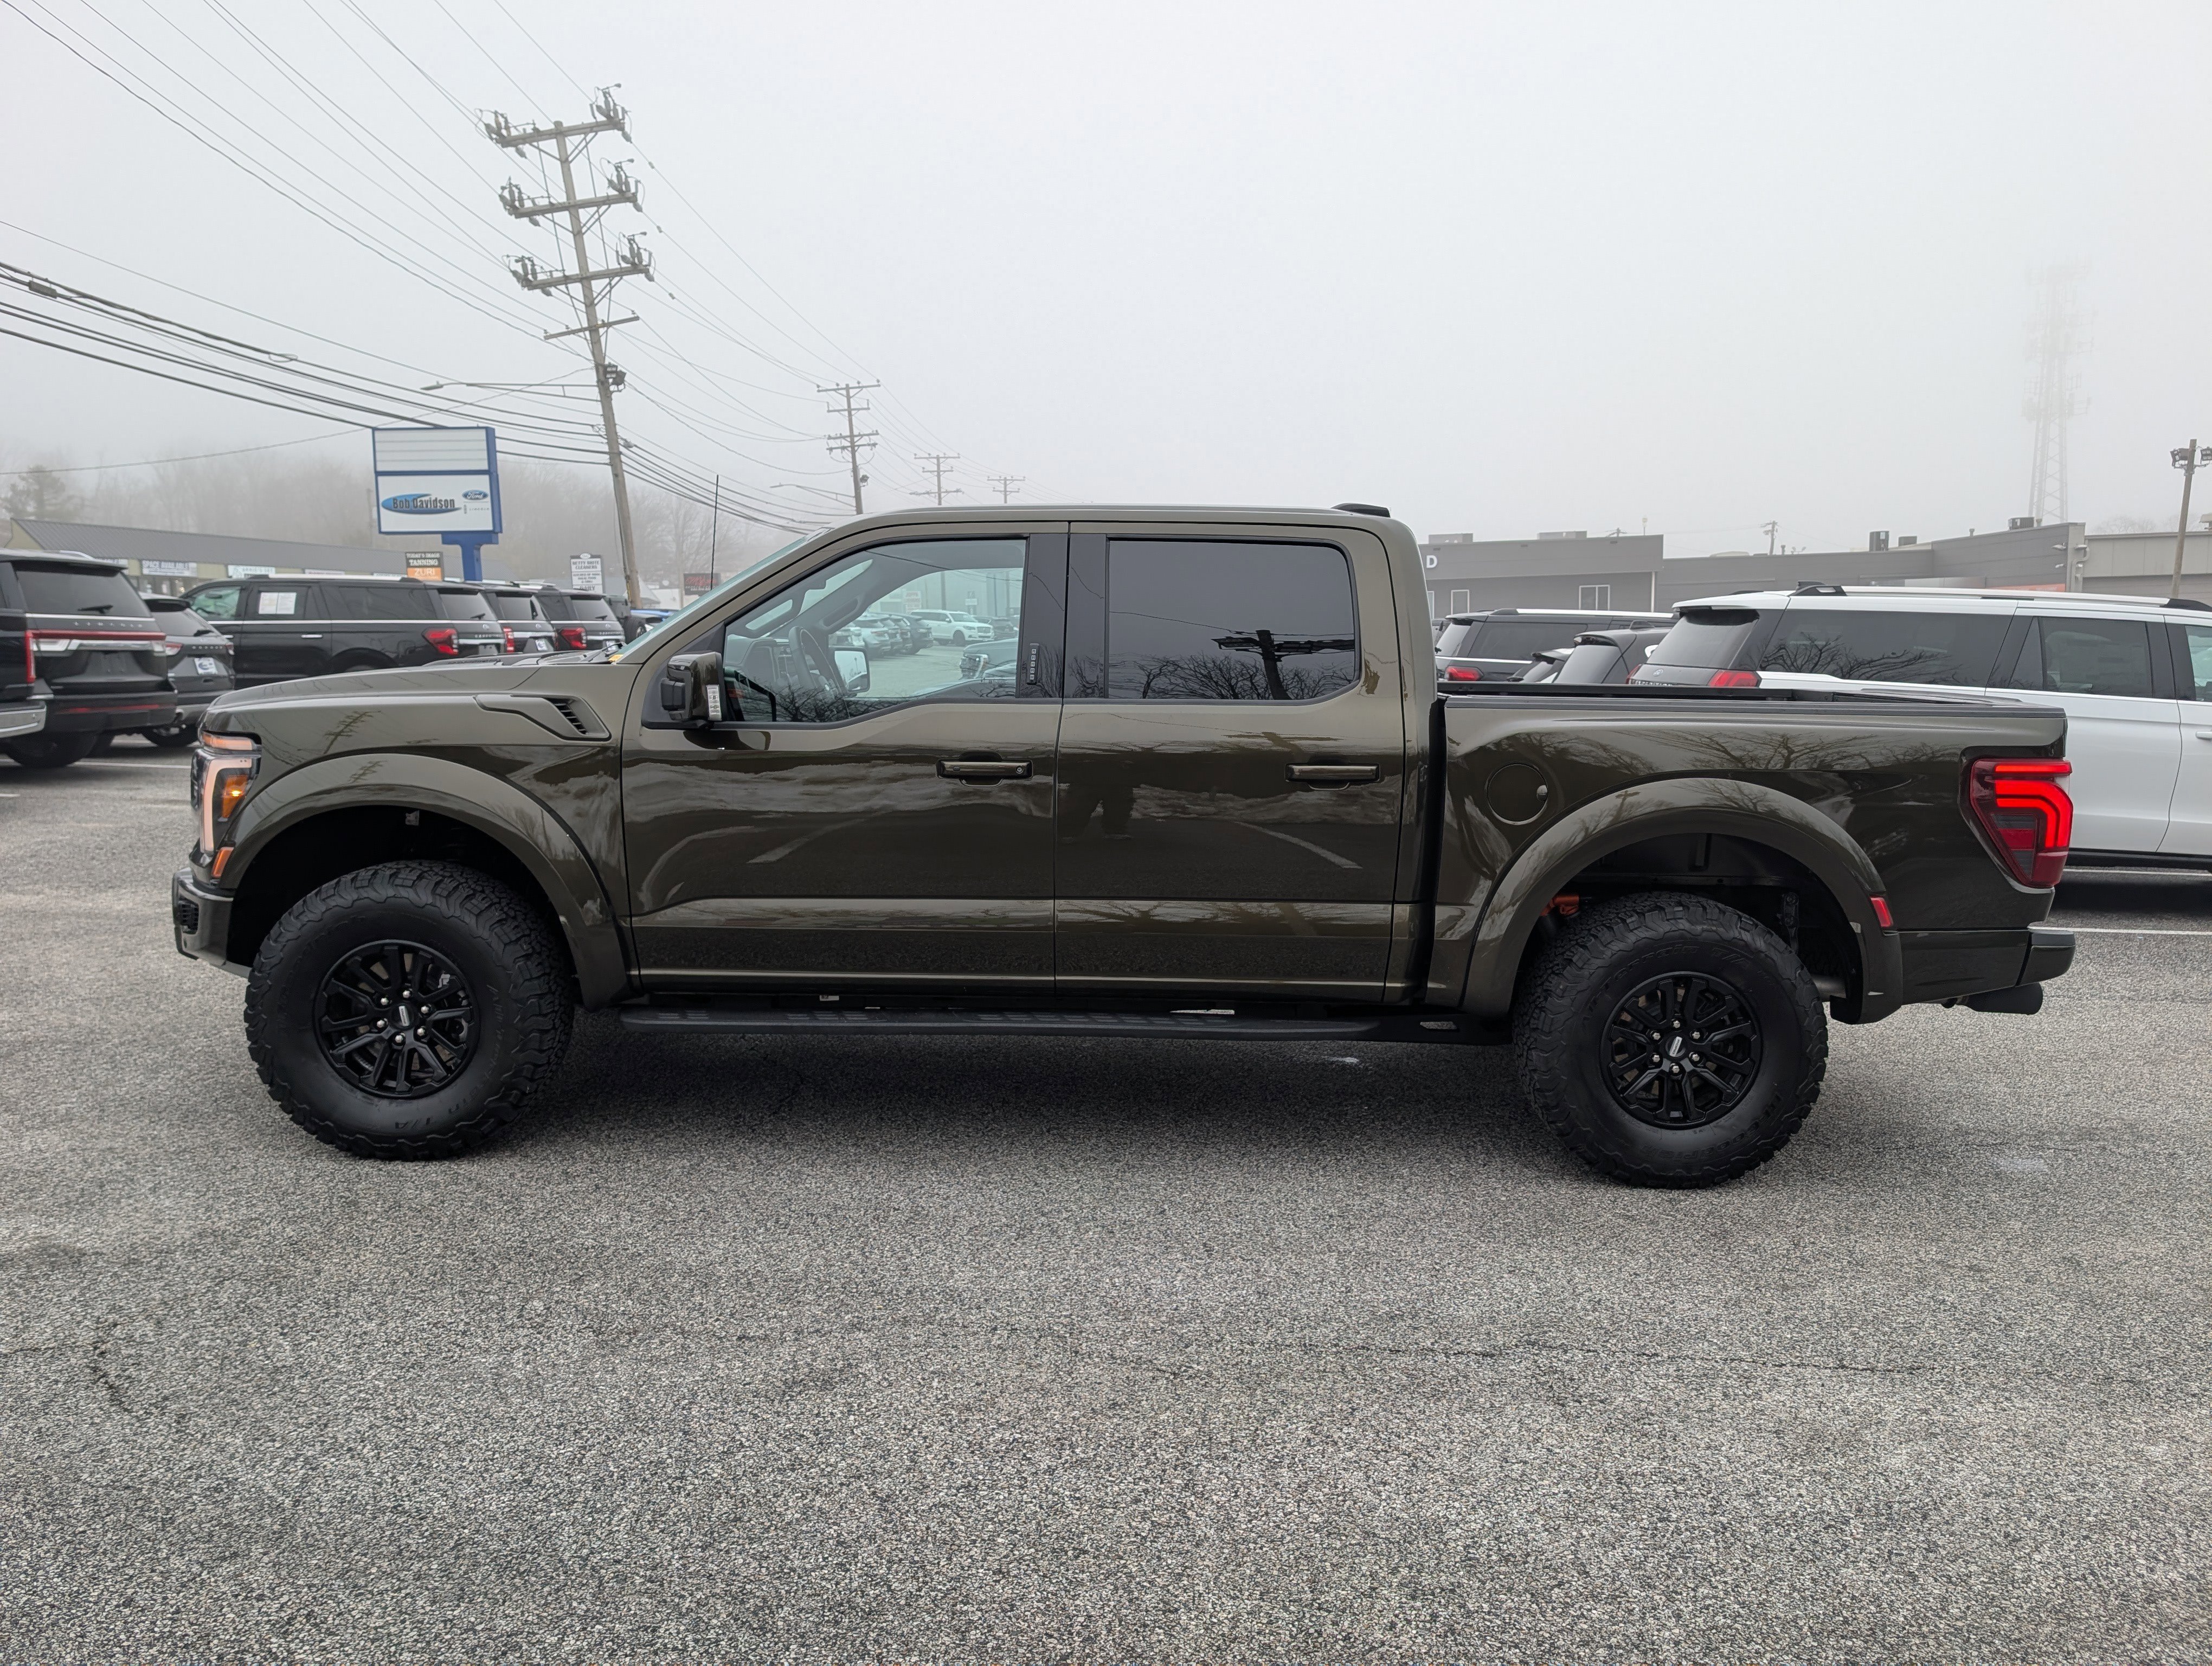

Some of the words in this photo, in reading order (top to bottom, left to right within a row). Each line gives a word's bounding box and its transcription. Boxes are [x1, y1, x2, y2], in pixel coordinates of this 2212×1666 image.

[393, 497, 410, 509] Bob
[413, 497, 455, 509] Davidson
[414, 568, 435, 577] ZURI
